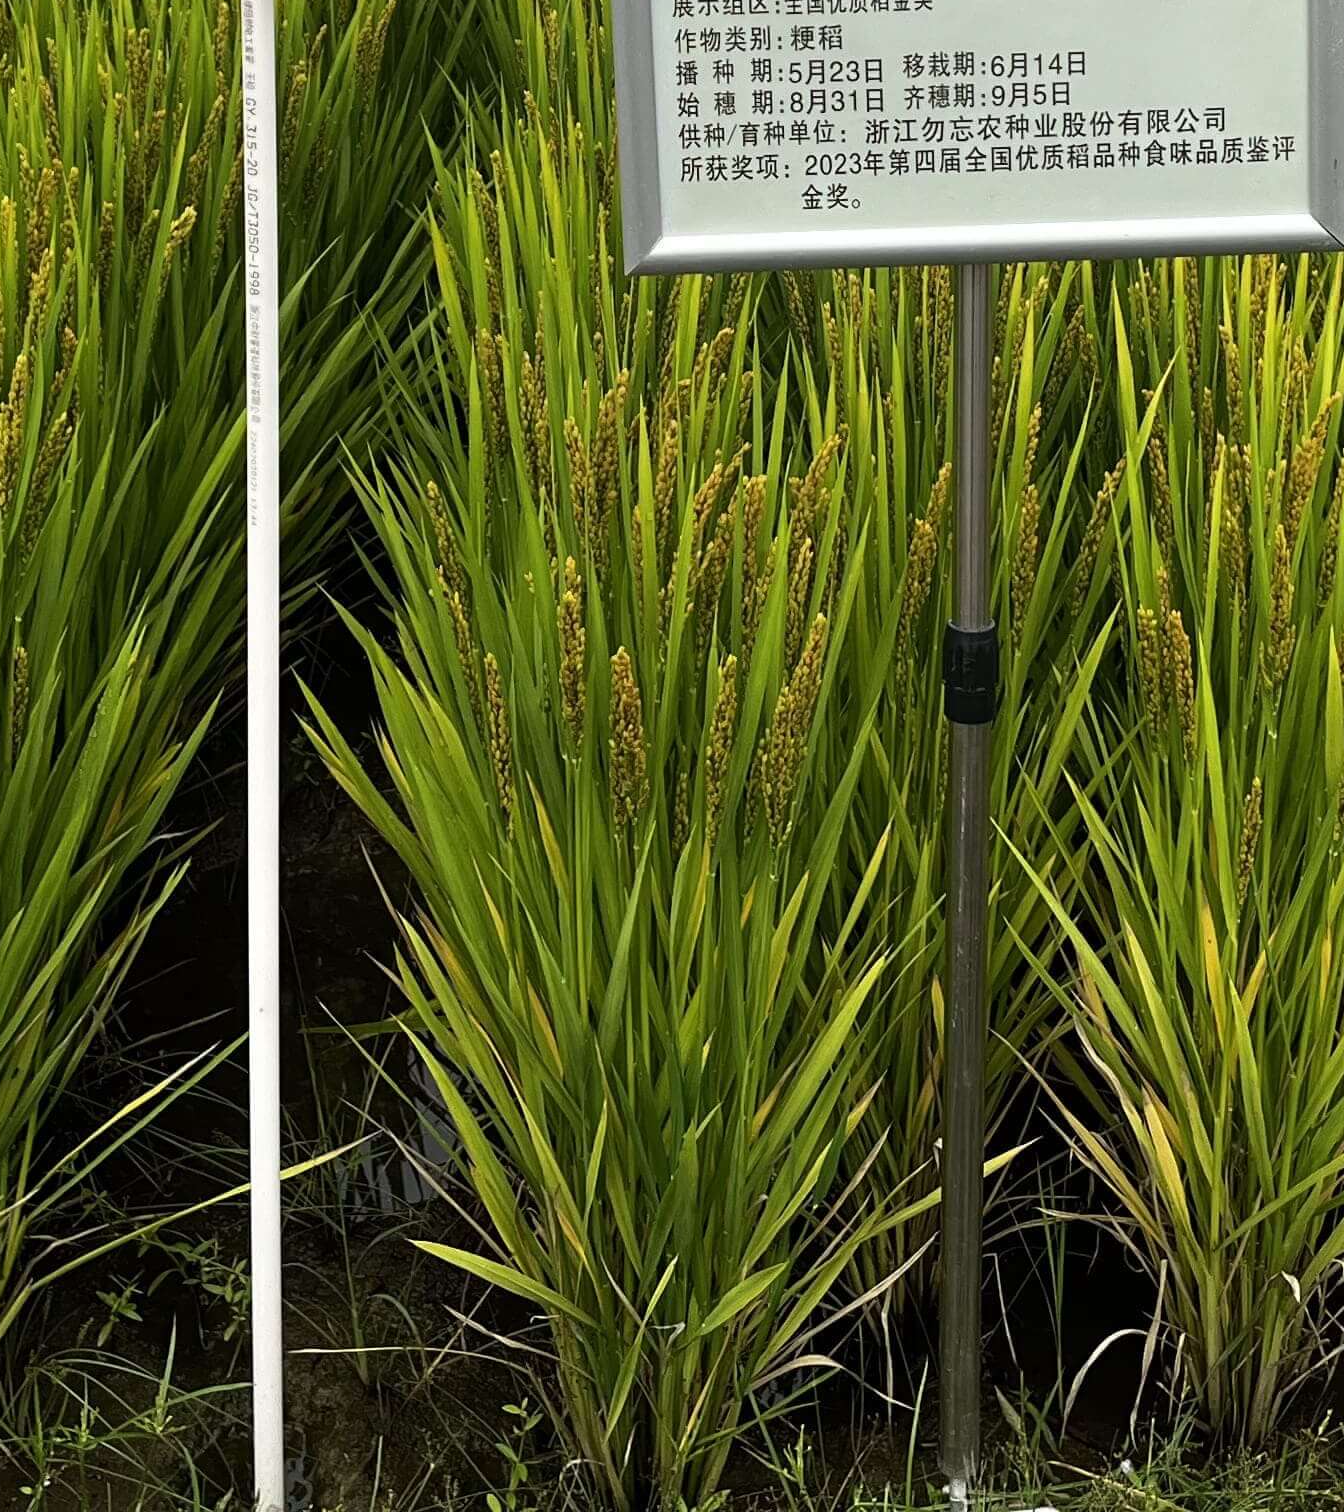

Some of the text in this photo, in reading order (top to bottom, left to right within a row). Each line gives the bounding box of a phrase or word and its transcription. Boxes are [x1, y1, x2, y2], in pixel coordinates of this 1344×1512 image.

[902, 51, 1087, 78] 移栽期:6月14日
[903, 81, 1072, 110] 齐穗期:9月5日
[801, 183, 862, 210] 金奖。
